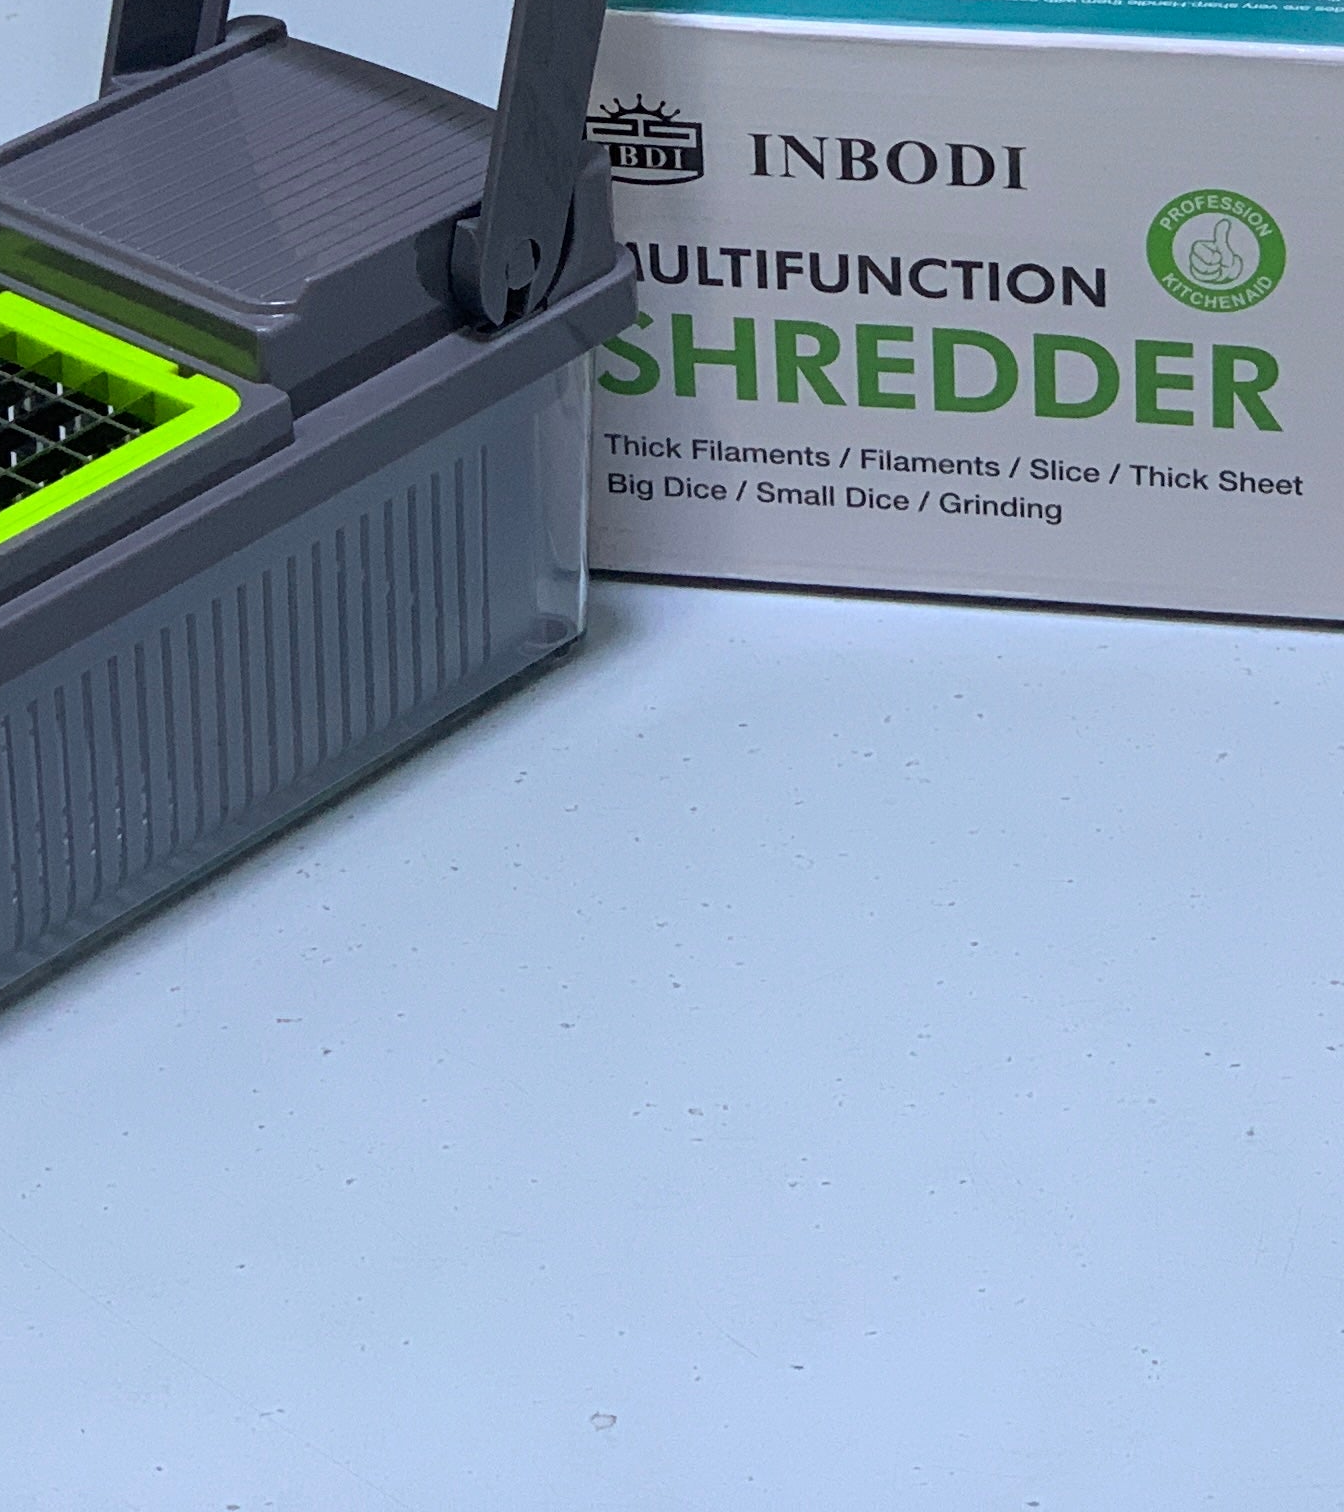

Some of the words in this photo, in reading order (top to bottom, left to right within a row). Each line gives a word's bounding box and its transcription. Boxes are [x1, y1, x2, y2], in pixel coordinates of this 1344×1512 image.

[747, 131, 1028, 191] INBODI
[1160, 195, 1273, 238] PROFESSION
[1162, 275, 1273, 309] KITCHENAID
[597, 310, 1284, 433] SHREDDER
[604, 433, 682, 459] Thick
[691, 439, 830, 468] Filaments
[839, 447, 852, 469] /
[861, 450, 1000, 478] Filaments
[1009, 457, 1022, 480] /
[1030, 459, 1101, 484] Slice
[1108, 464, 1122, 486] /
[1130, 465, 1210, 491] Thick
[1218, 471, 1303, 497] Sheet
[608, 473, 653, 503] Big
[663, 476, 727, 503] Dice
[736, 480, 748, 503] /
[757, 481, 835, 509] Small
[845, 487, 910, 513] Dice
[918, 490, 930, 513] /
[939, 493, 1063, 525] Grinding
